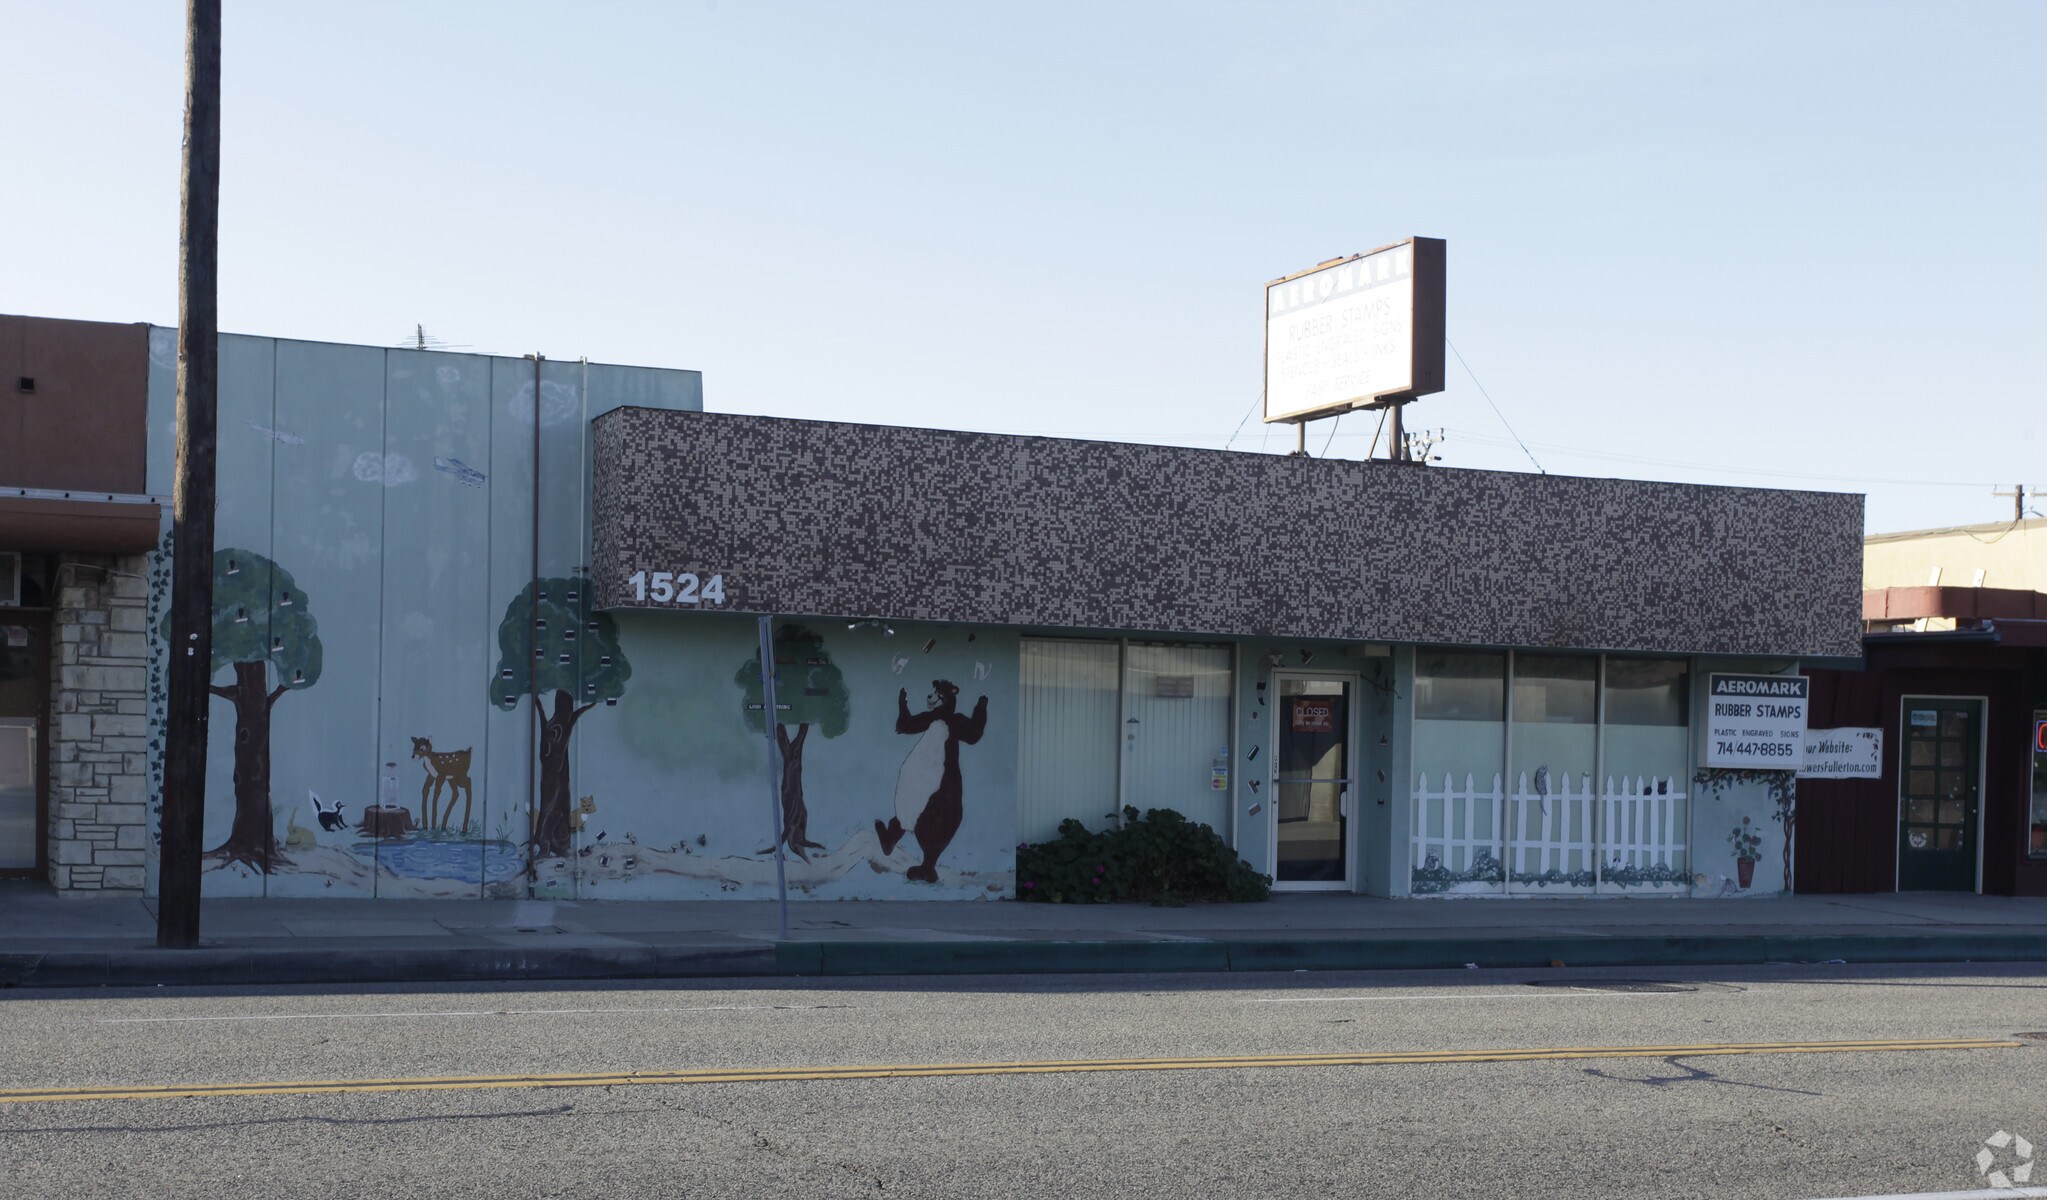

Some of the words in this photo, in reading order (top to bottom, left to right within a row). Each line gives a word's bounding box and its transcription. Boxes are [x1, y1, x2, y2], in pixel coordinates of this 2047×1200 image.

[1272, 249, 1409, 313] AEROMARK
[1289, 314, 1332, 344] RUBBER
[1342, 296, 1390, 328] STAMPS
[1275, 344, 1310, 366] PLASTIC
[1316, 328, 1366, 354] ENGRAVED
[1374, 318, 1402, 339] SIGNS
[1332, 349, 1359, 369] SEALS
[1371, 339, 1396, 361] INKS
[1306, 379, 1328, 399] FAST
[1334, 369, 1371, 392] SERVICE
[629, 571, 725, 604] 1524
[1716, 680, 1801, 695] AEROMARK
[1296, 706, 1329, 717] CLOSED
[1715, 703, 1752, 717] RUBBER
[1756, 704, 1801, 719] STAMPS
[1714, 728, 1737, 737] PLASTIC
[1742, 729, 1773, 737] ENGRAVED
[1780, 730, 1799, 738] SIGNS
[1818, 739, 1853, 754] Website:
